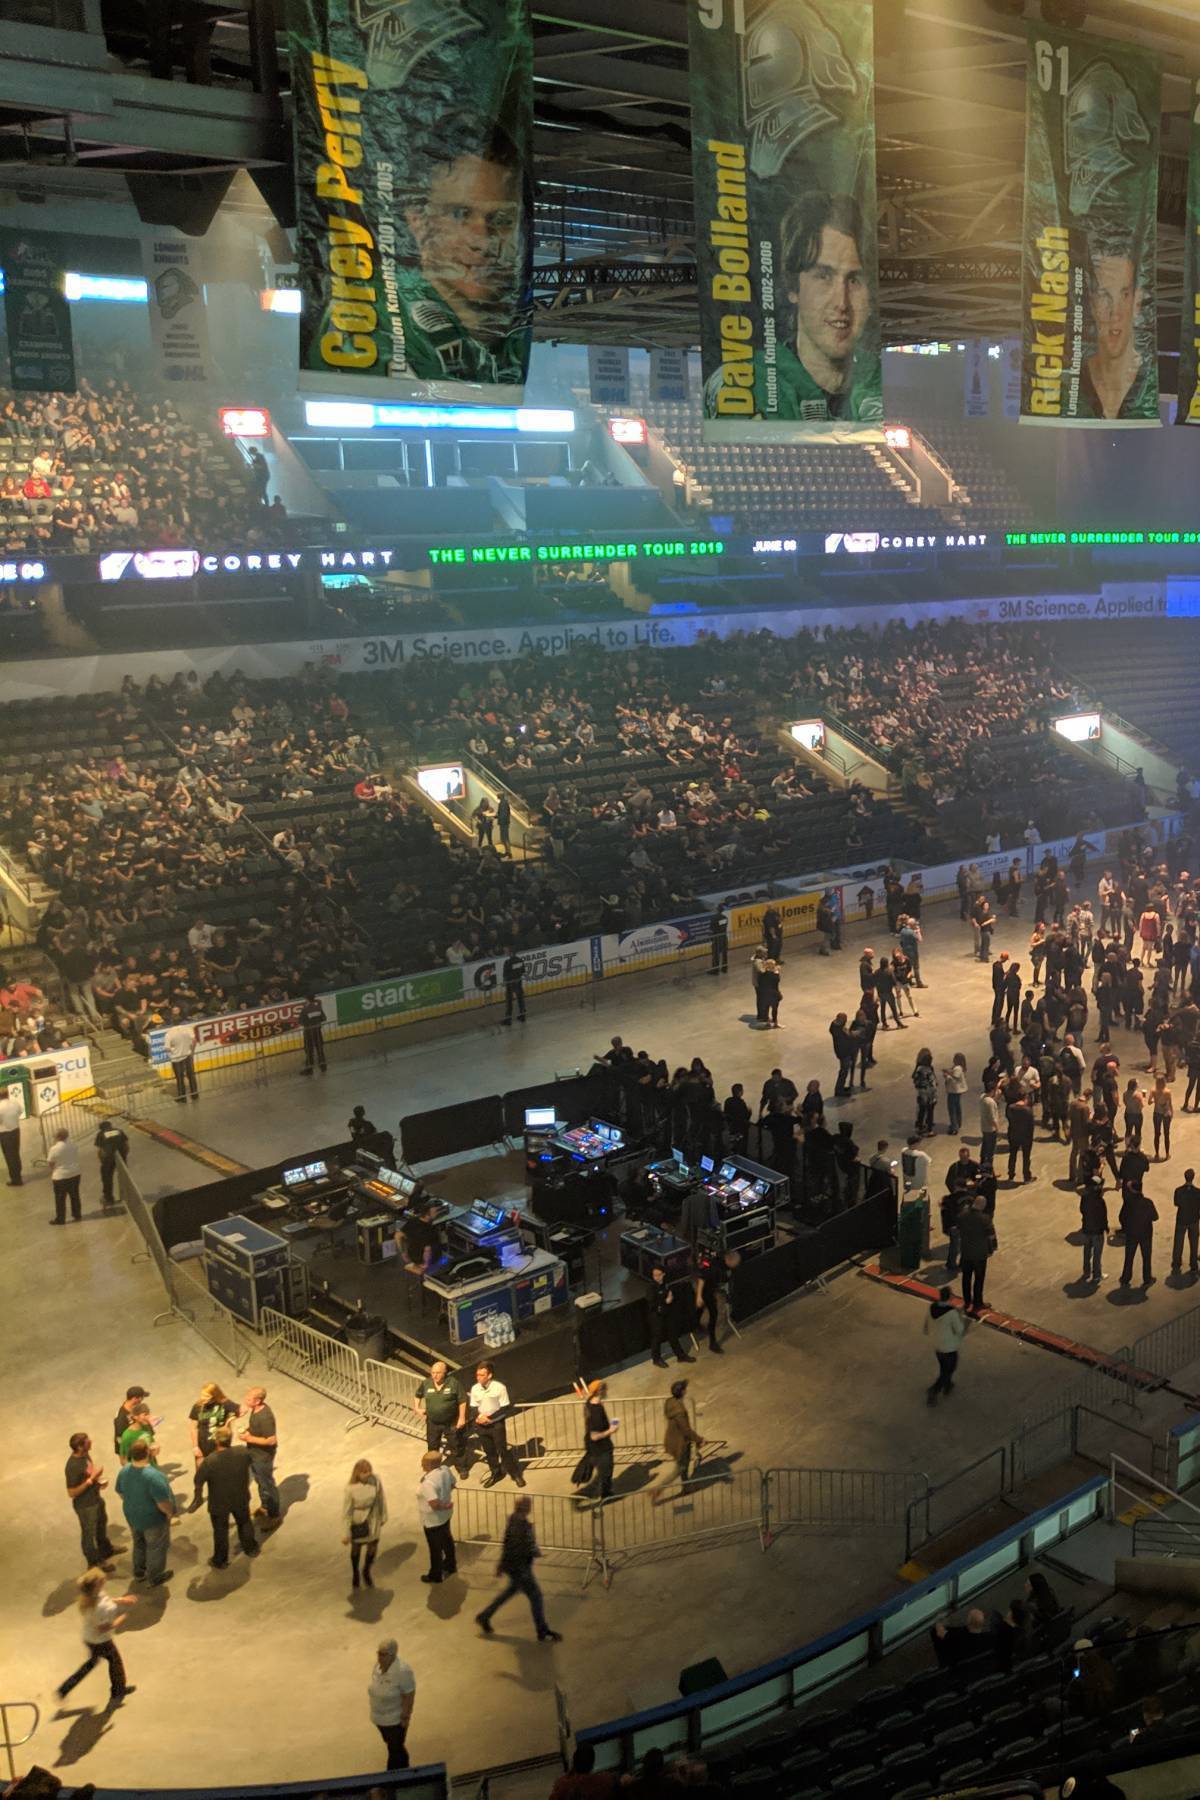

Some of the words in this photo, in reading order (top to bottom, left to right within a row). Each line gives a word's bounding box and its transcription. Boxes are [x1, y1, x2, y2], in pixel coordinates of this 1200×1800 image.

[1035, 40, 1069, 95] 61
[312, 51, 369, 206] Perry
[376, 161, 394, 202] 2005
[378, 215, 396, 255] 2001
[707, 139, 751, 302] Bolland
[320, 214, 378, 368] Corey
[383, 257, 401, 314] Knights
[760, 241, 775, 311] 2002-2006
[1030, 226, 1070, 323] Nash
[1074, 266, 1084, 295] 2002
[1073, 305, 1084, 333] 2000
[391, 317, 407, 377] London
[763, 316, 777, 365] Knights
[1071, 335, 1082, 376] Knights
[717, 313, 755, 416] Dave
[1030, 331, 1066, 415] Rick
[766, 366, 778, 413] London
[1067, 377, 1080, 416] London
[428, 549, 466, 564] THE
[472, 547, 532, 563] NEVER
[537, 544, 638, 561] SURRENDER
[643, 542, 686, 556] TOUR
[690, 541, 724, 555] 2019
[882, 536, 936, 548] COREY
[946, 535, 986, 546] HART
[1005, 533, 1027, 545] THE
[1029, 533, 1066, 544] NEVER
[1070, 533, 1144, 544] SURRENDER
[1148, 533, 1180, 543] TOUR
[203, 554, 301, 571] COREY
[321, 551, 393, 567] HART
[998, 601, 1022, 617] 3M
[1094, 597, 1152, 616] Applied
[363, 640, 404, 665] 3M
[412, 636, 512, 659] Science.
[518, 627, 601, 654] Applied
[607, 628, 628, 646] to
[633, 624, 675, 645] Life.
[473, 962, 498, 991] G
[198, 1003, 305, 1043] FIREHOUS
[237, 1022, 284, 1042] SUBS
